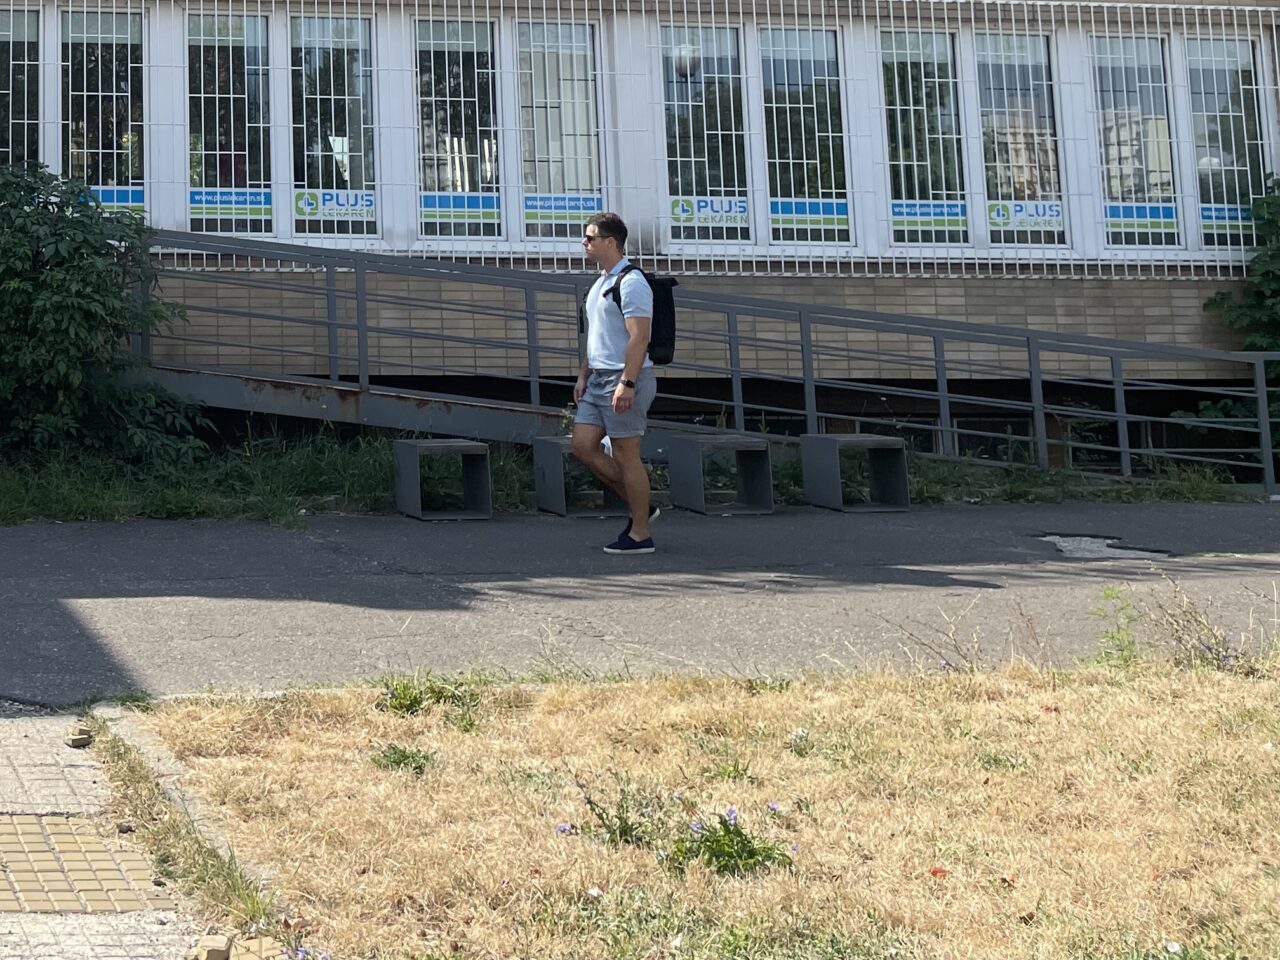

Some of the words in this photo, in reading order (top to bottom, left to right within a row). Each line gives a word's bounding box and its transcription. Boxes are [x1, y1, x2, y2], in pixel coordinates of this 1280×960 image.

[322, 192, 373, 207] PLUS
[696, 199, 747, 214] PLUS
[1014, 203, 1061, 217] PLUS
